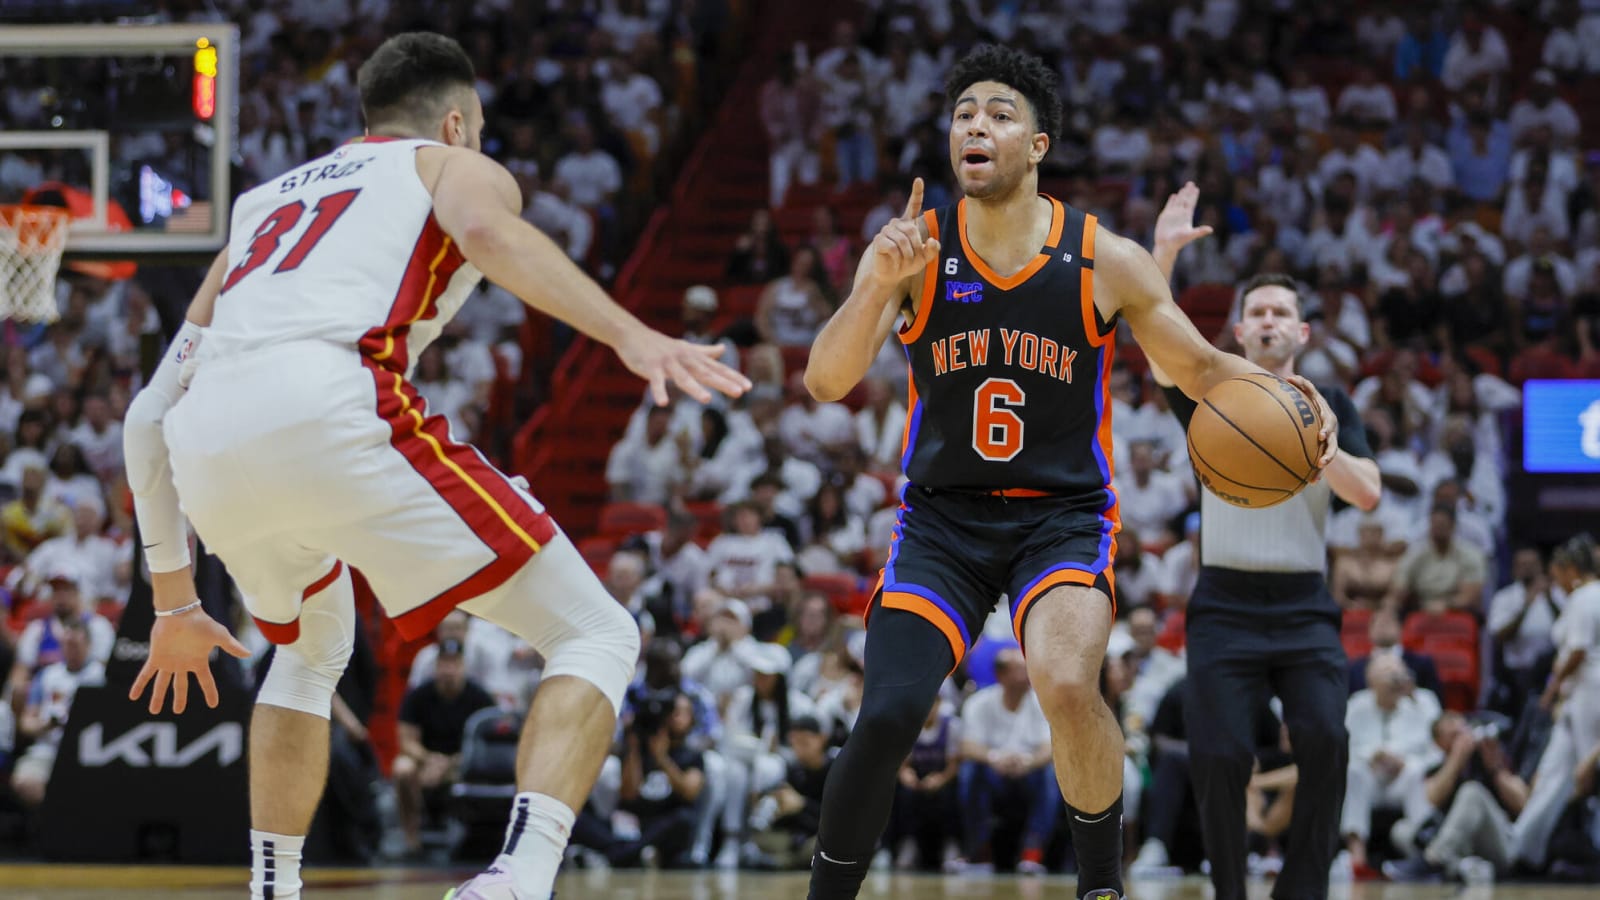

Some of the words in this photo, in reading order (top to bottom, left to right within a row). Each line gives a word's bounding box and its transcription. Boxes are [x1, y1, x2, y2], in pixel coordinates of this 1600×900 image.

[220, 187, 363, 296] 31
[1063, 252, 1072, 263] 19
[945, 257, 959, 275] 6
[945, 280, 983, 303] NYC
[931, 328, 991, 377] NEW
[1000, 328, 1078, 385] YORK
[972, 377, 1026, 462] 6
[78, 721, 243, 768] KIA
